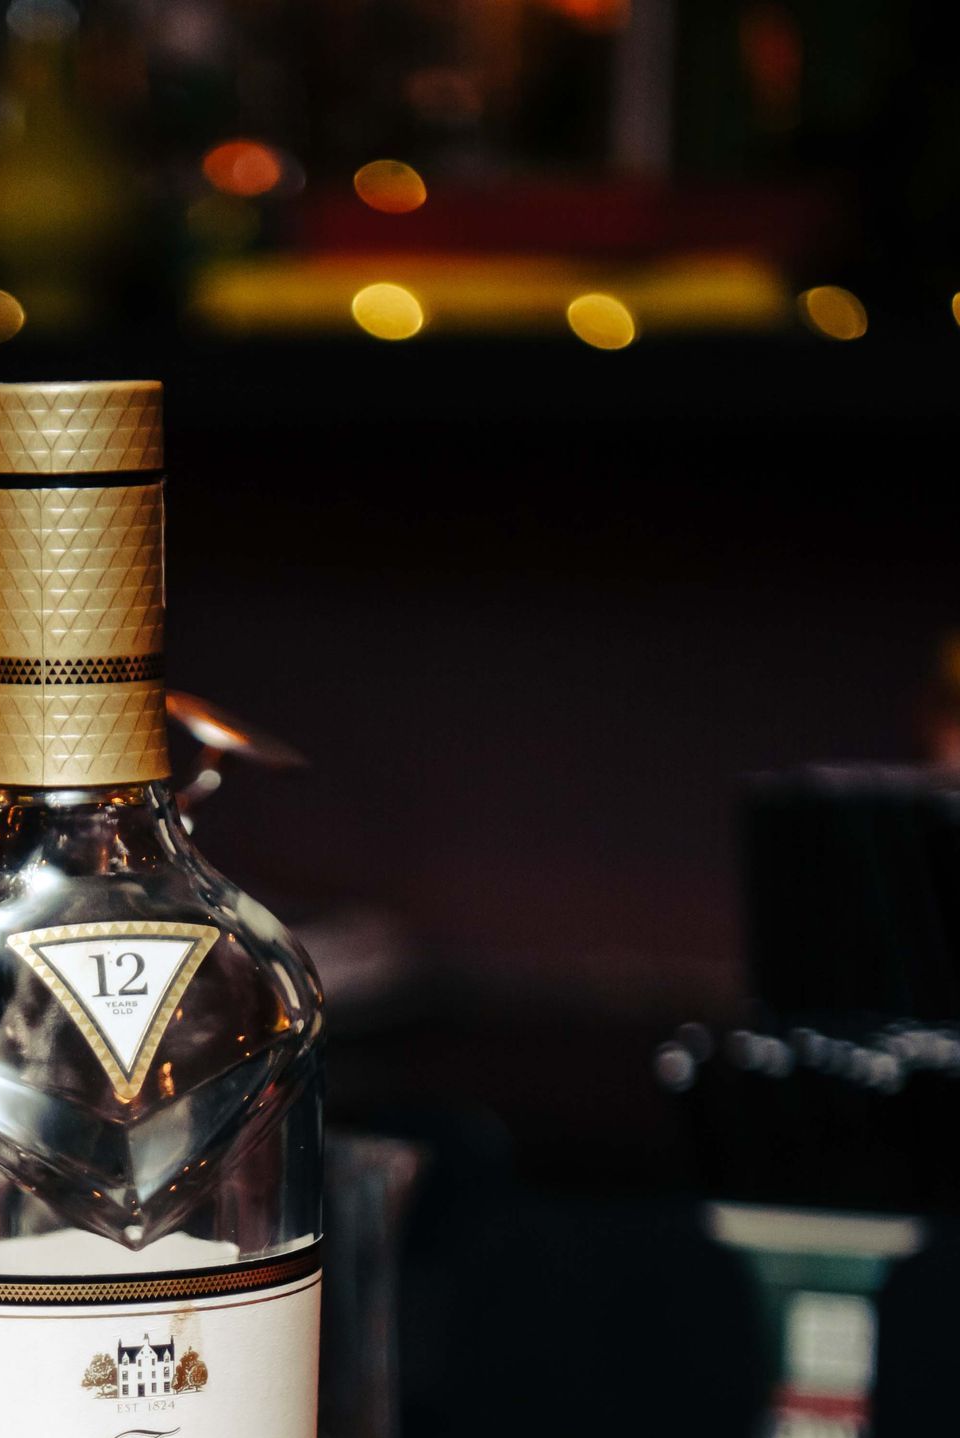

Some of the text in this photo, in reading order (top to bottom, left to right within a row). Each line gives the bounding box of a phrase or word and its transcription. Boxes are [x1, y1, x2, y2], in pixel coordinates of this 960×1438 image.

[88, 952, 149, 998] 12
[117, 1400, 175, 1413] EST 1824
